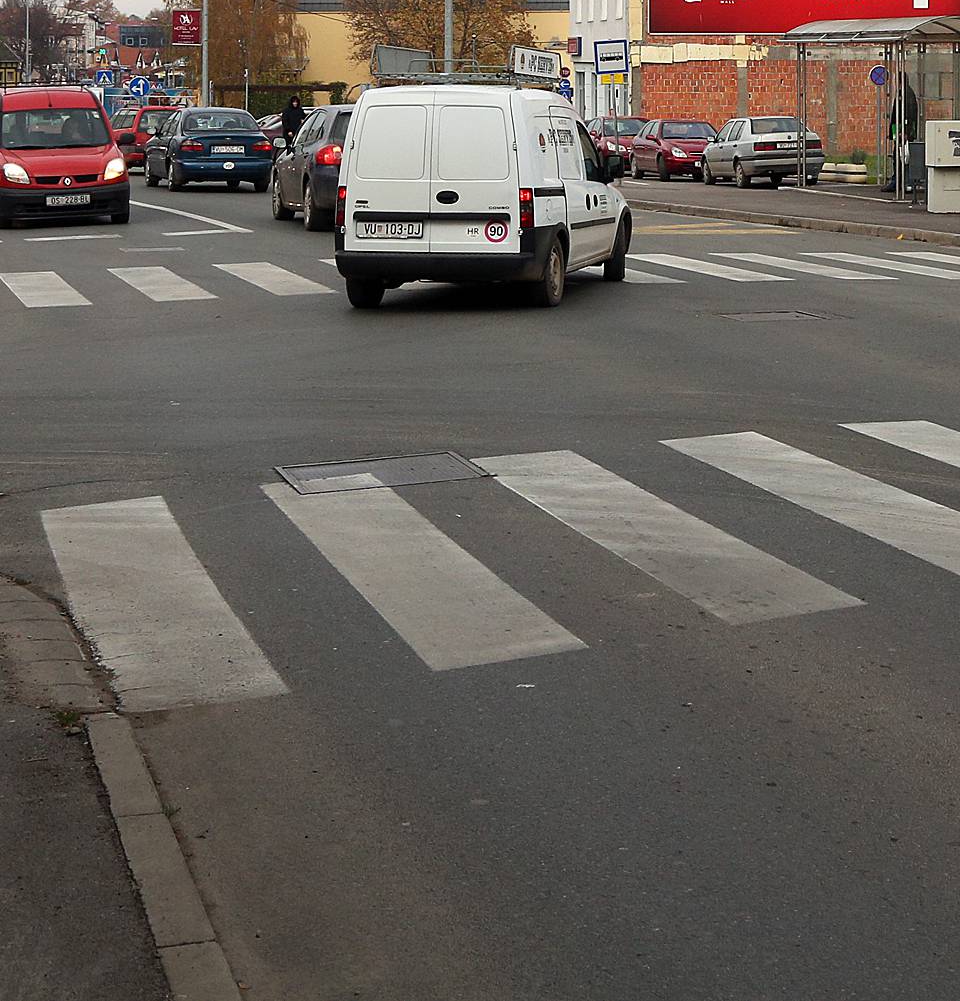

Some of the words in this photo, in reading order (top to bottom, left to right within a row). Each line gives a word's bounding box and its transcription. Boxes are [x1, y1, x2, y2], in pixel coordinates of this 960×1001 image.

[364, 223, 377, 235] VU
[385, 223, 421, 236] 103-DJ
[467, 227, 480, 235] HR
[489, 225, 504, 237] 90
